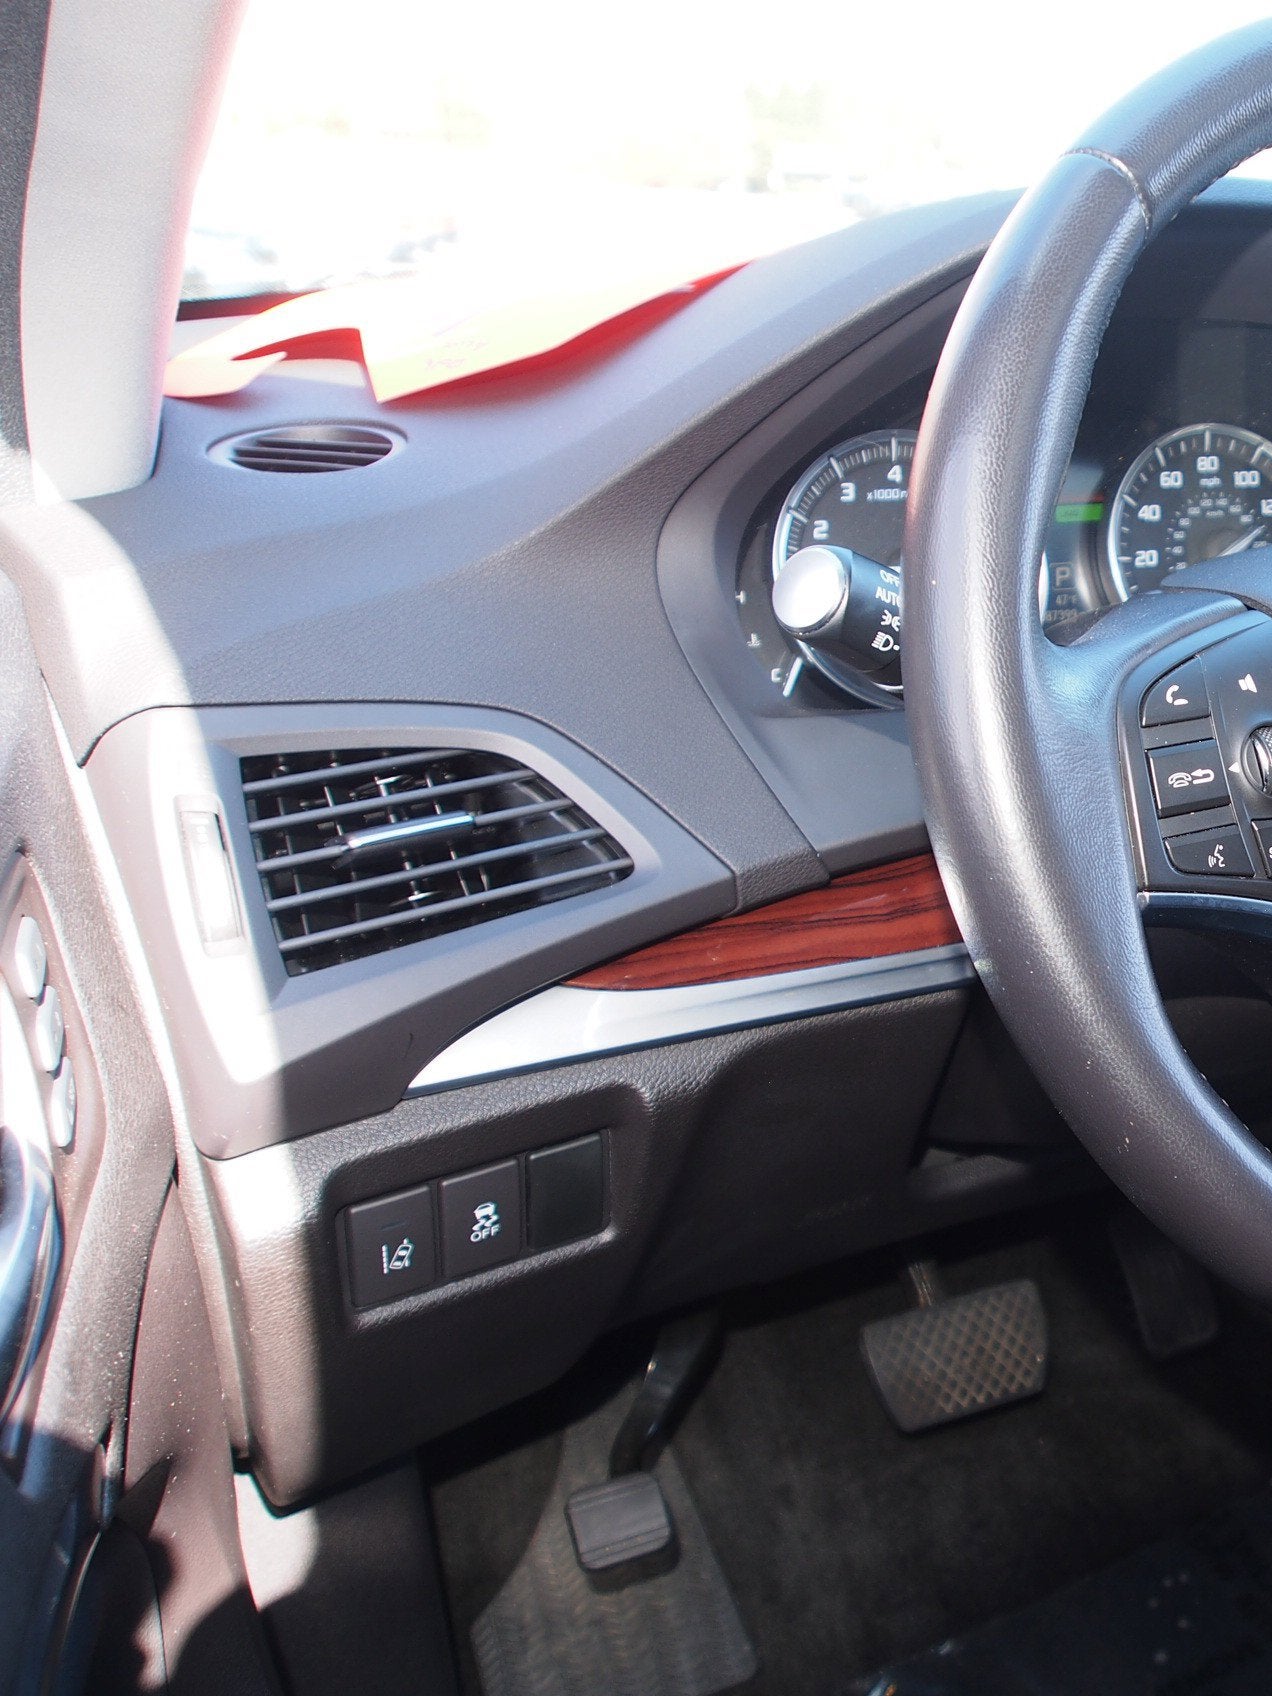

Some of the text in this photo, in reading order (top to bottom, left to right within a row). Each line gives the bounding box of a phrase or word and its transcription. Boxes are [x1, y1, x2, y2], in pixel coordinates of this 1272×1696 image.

[1197, 455, 1220, 471] 80
[887, 465, 903, 483] 4
[1159, 470, 1184, 489] 60
[1200, 477, 1222, 488] mph
[1233, 470, 1261, 488] 100
[840, 482, 856, 501] 3
[1137, 504, 1162, 522] 40
[812, 519, 830, 540] 2
[1134, 550, 1159, 568] 20
[1055, 566, 1072, 587] P
[770, 667, 782, 684] C
[470, 1225, 501, 1243] OFF
